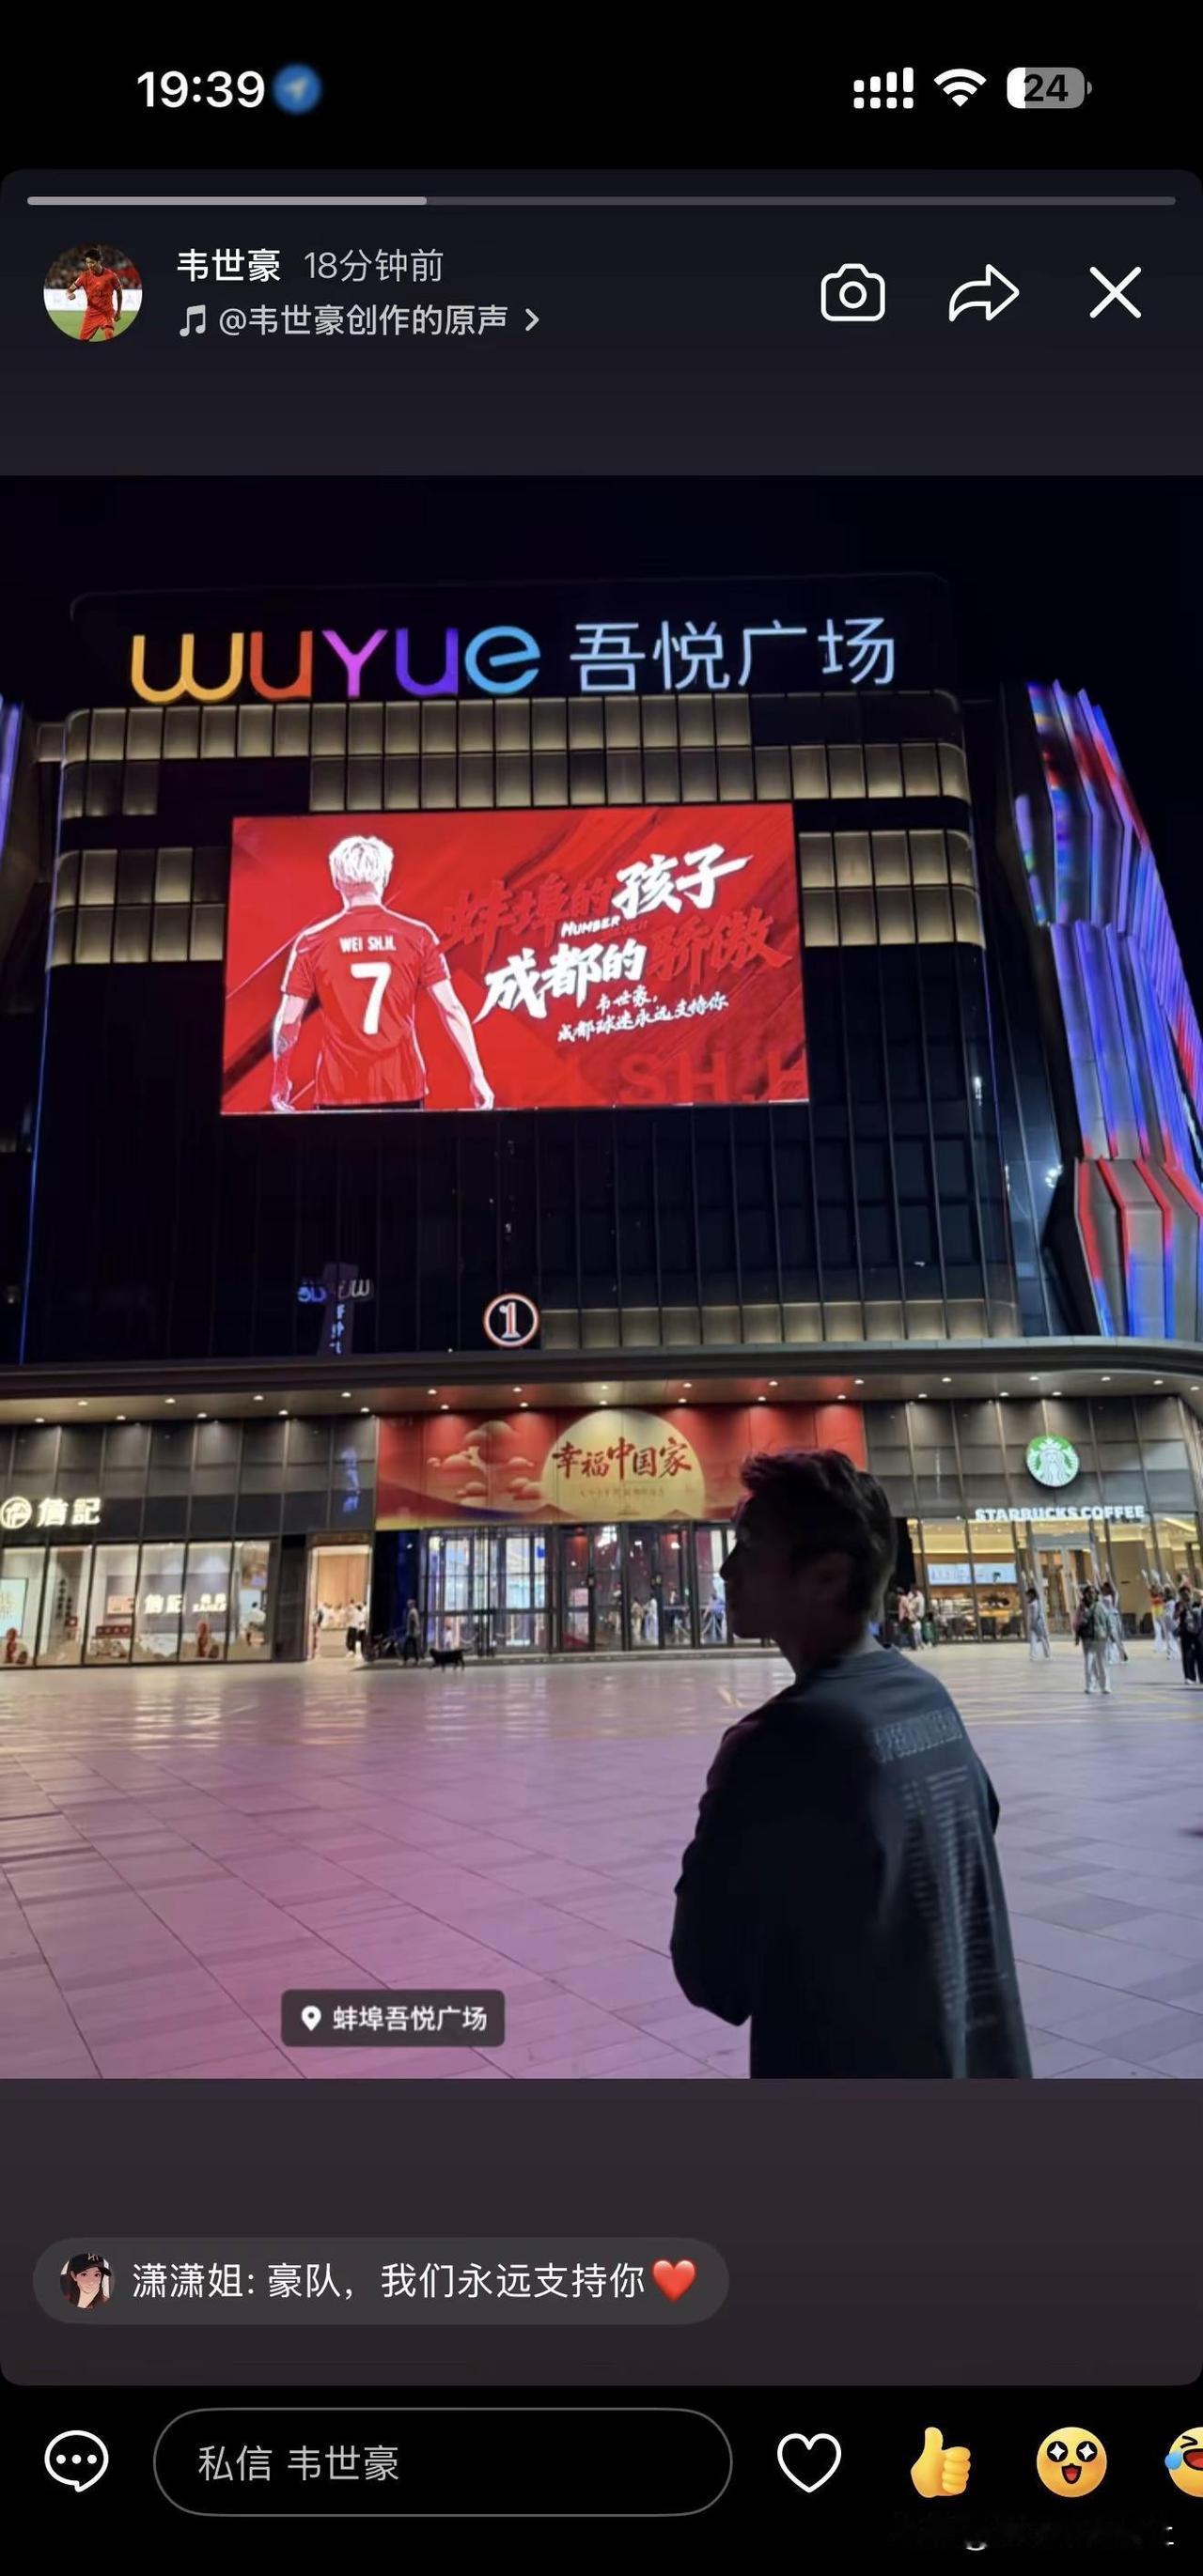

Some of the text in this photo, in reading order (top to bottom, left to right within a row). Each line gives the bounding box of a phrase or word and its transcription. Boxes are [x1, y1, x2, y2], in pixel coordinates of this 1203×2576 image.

[570, 617, 896, 692] 吾悦广场
[339, 936, 364, 953] WEI
[351, 961, 392, 1035] 7
[552, 1436, 692, 1480] 幸福中国家
[975, 1505, 1145, 1521] STARBUCKS COFFEE
